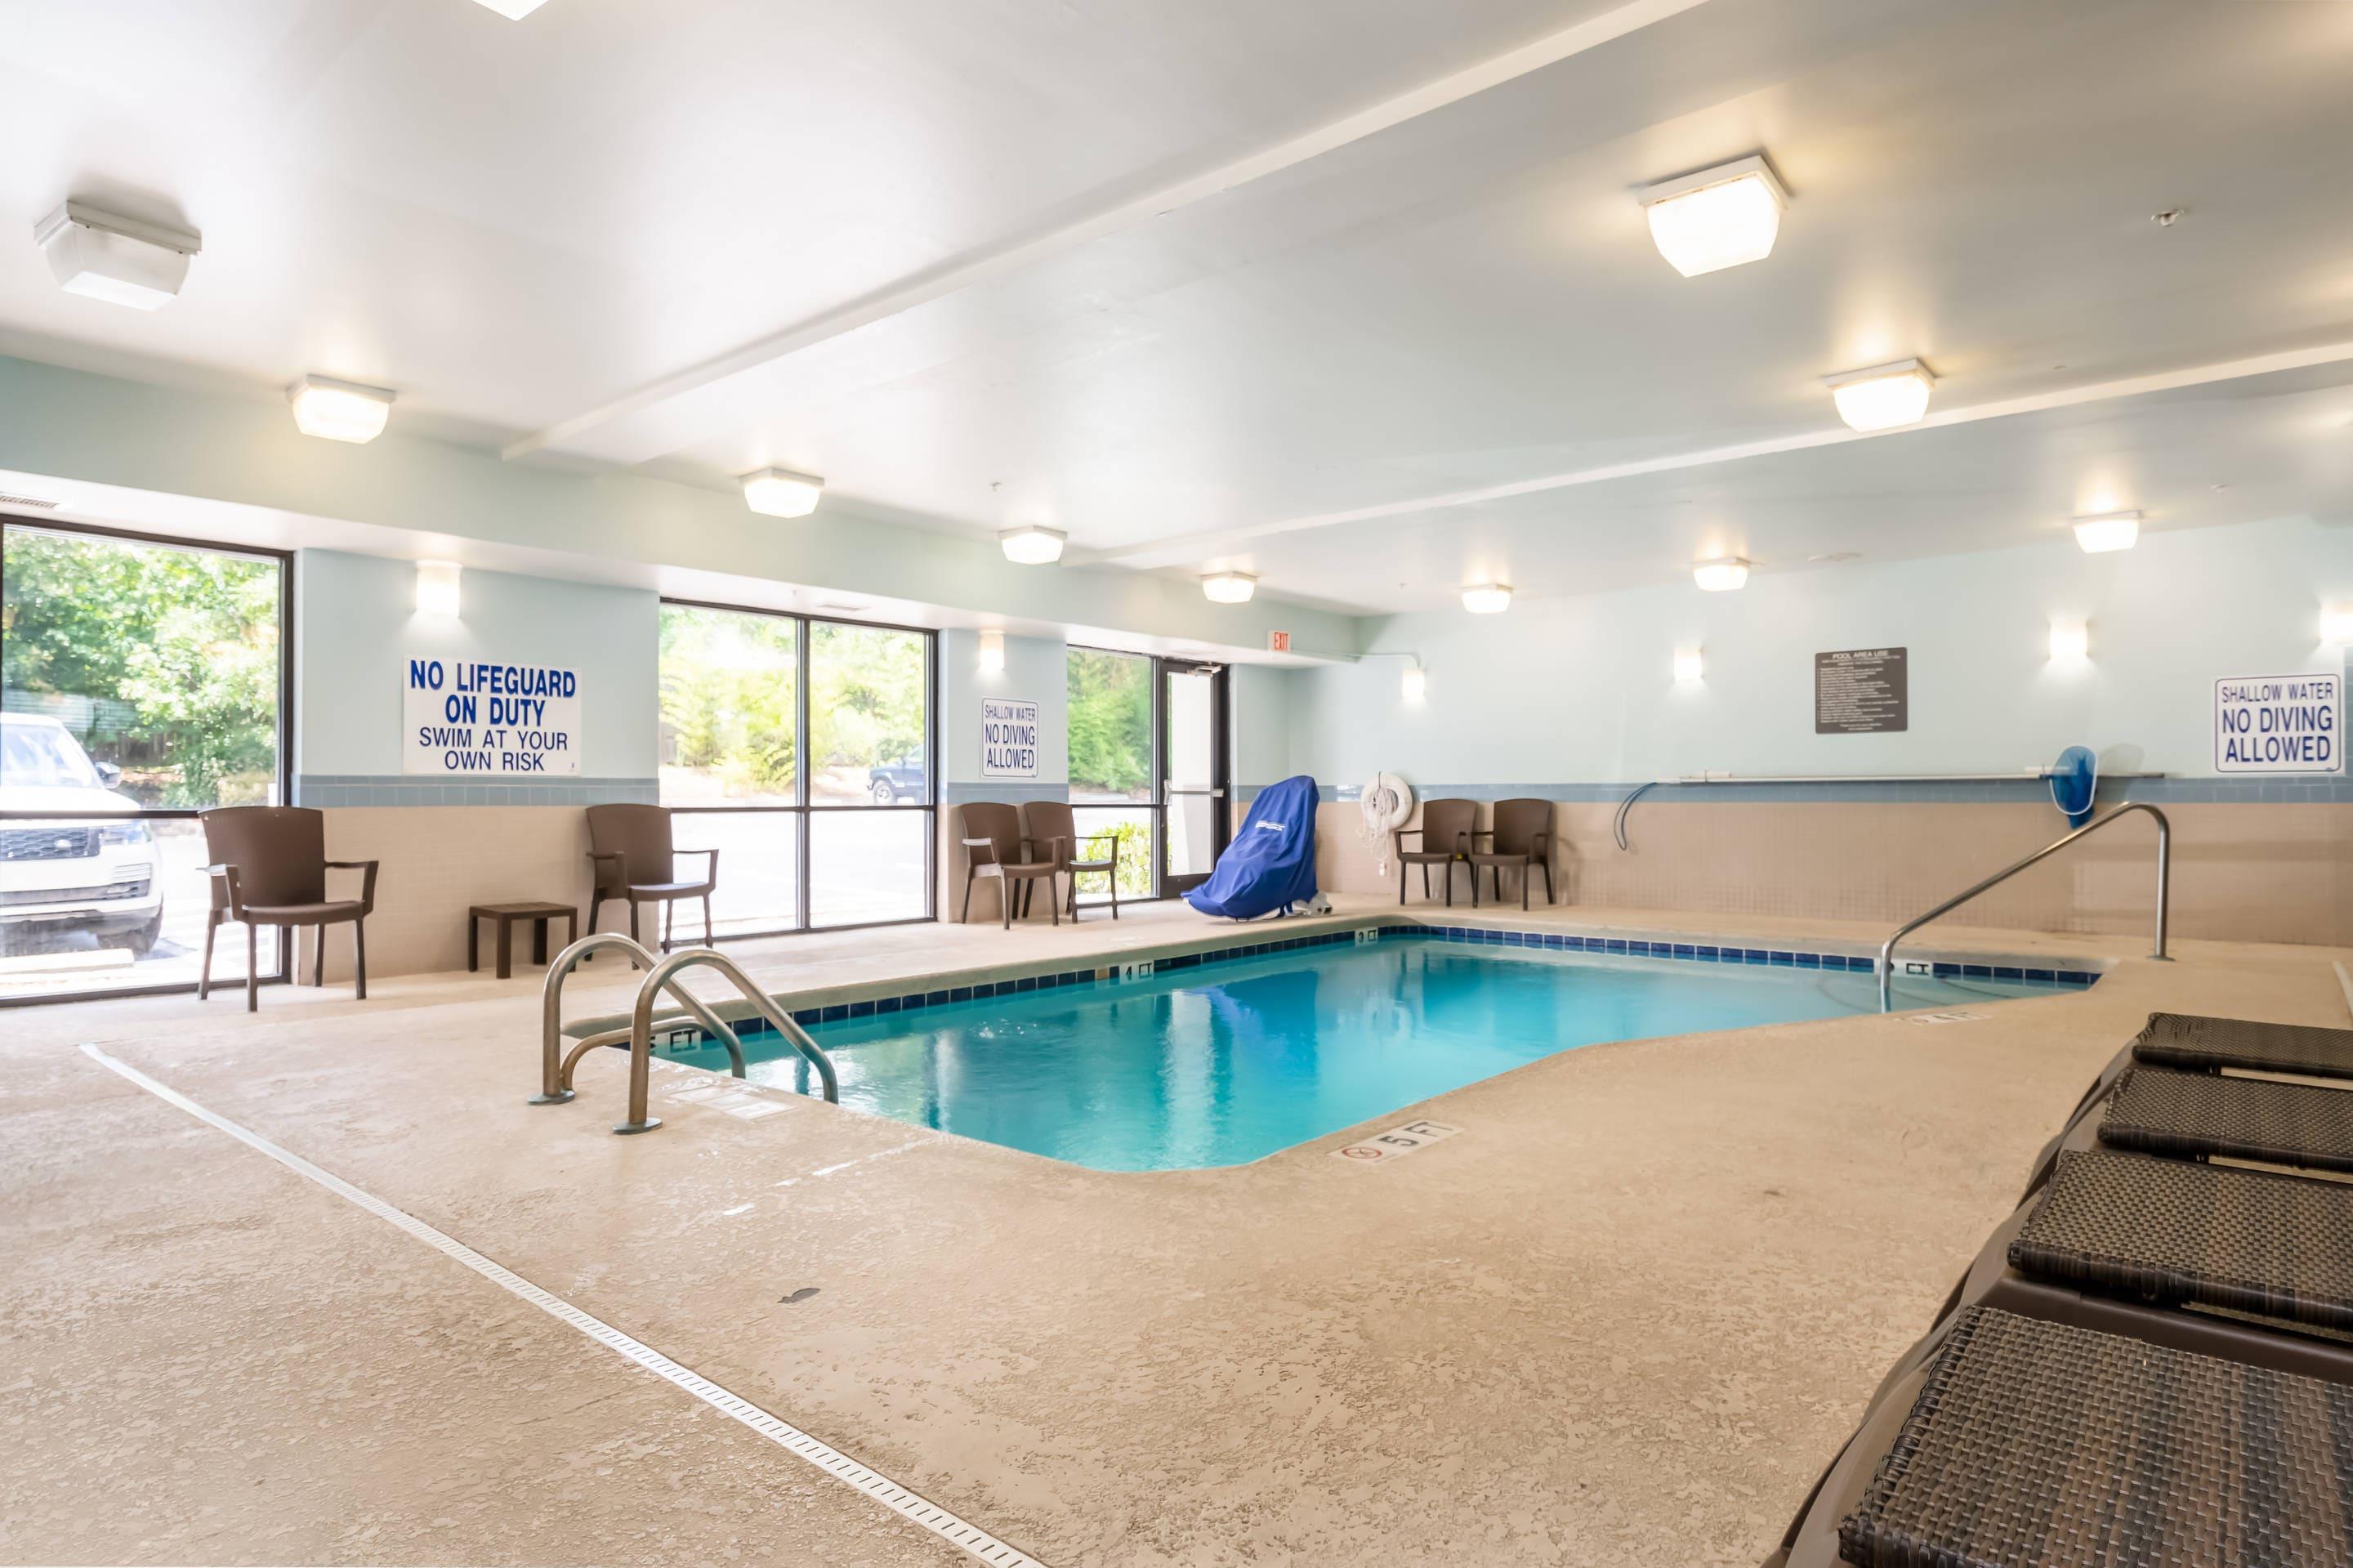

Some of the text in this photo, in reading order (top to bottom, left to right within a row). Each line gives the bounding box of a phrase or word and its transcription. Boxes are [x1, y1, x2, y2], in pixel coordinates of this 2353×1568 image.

[1274, 632, 1288, 650] EXIT
[410, 659, 576, 698] NO LIFEGUARD
[2221, 682, 2333, 703] SHALLOW WATER
[445, 695, 546, 726] ON DUTY
[985, 705, 1036, 721] SHALLOW WATER
[2222, 705, 2333, 733] NO DIVING
[419, 726, 568, 750] SWIM AT YOUR
[985, 723, 1035, 745] NO DIVING
[986, 748, 1034, 768] ALLOWED
[2226, 735, 2331, 762] ALLOWED
[444, 750, 545, 771] OWN RISK
[1377, 1121, 1454, 1147] 5 FT
